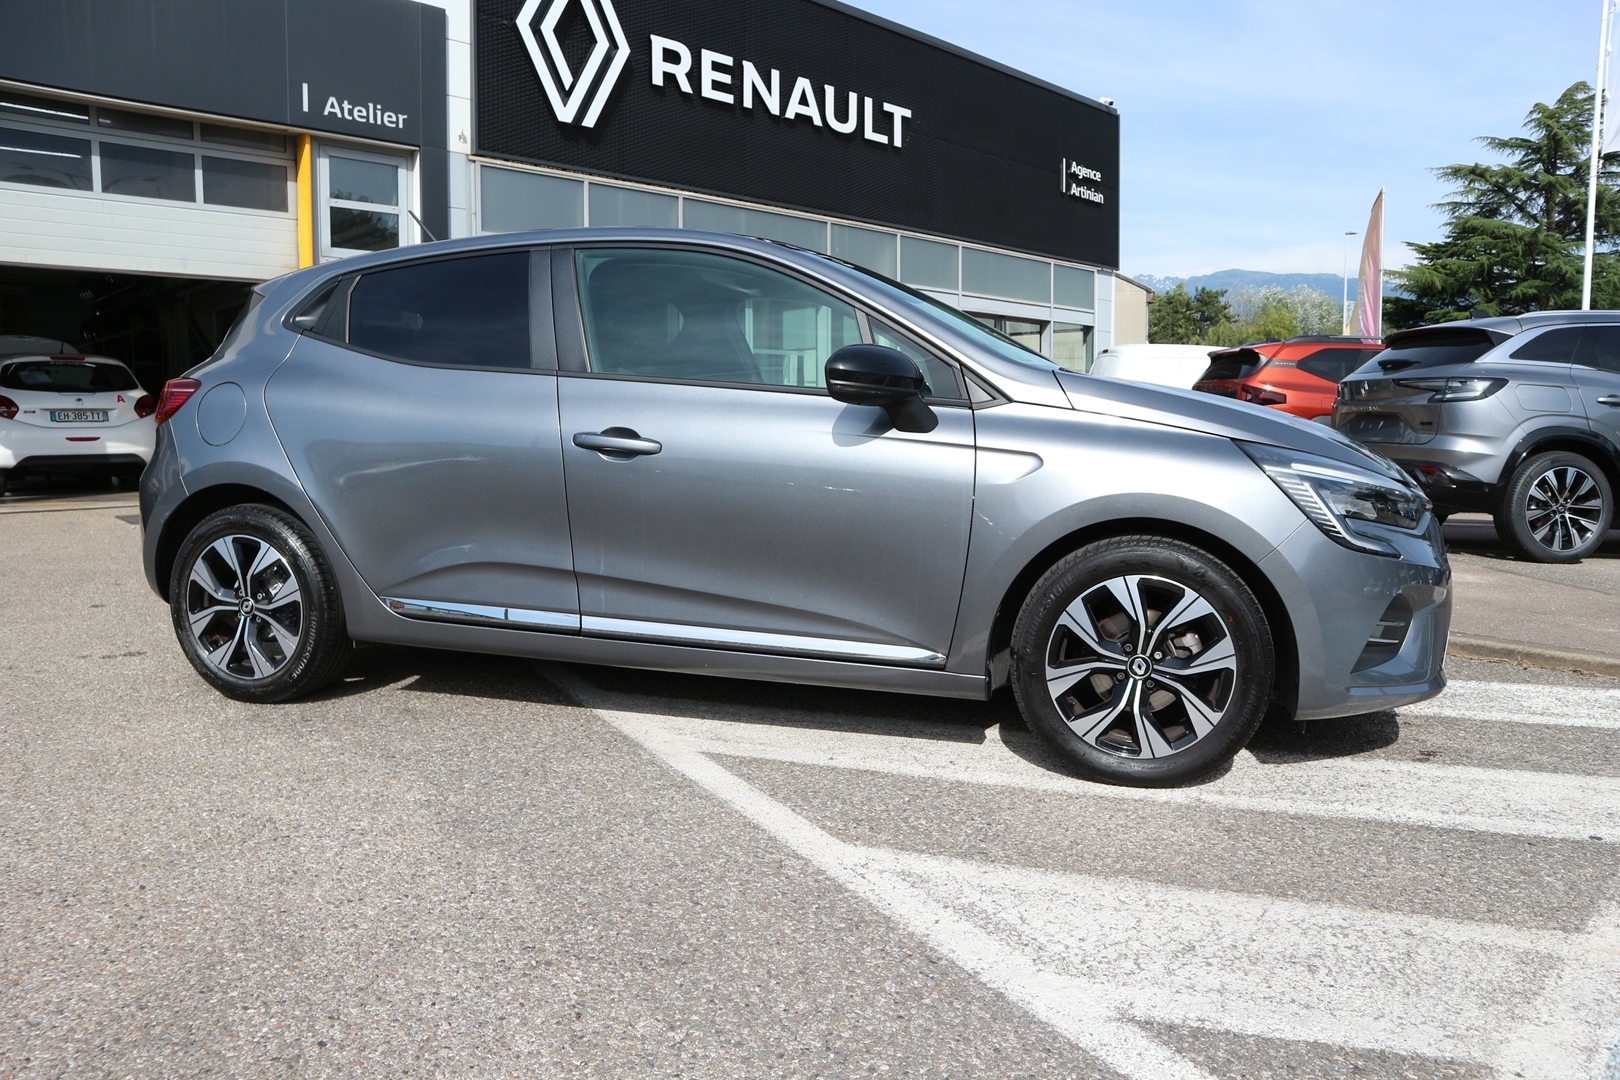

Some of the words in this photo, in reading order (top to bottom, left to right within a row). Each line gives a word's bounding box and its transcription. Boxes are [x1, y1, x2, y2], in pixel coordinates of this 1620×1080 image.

[650, 34, 912, 148] RENAULT
[323, 96, 408, 129] Atelier
[1071, 161, 1102, 182] Agence
[1070, 183, 1105, 204] Artinian
